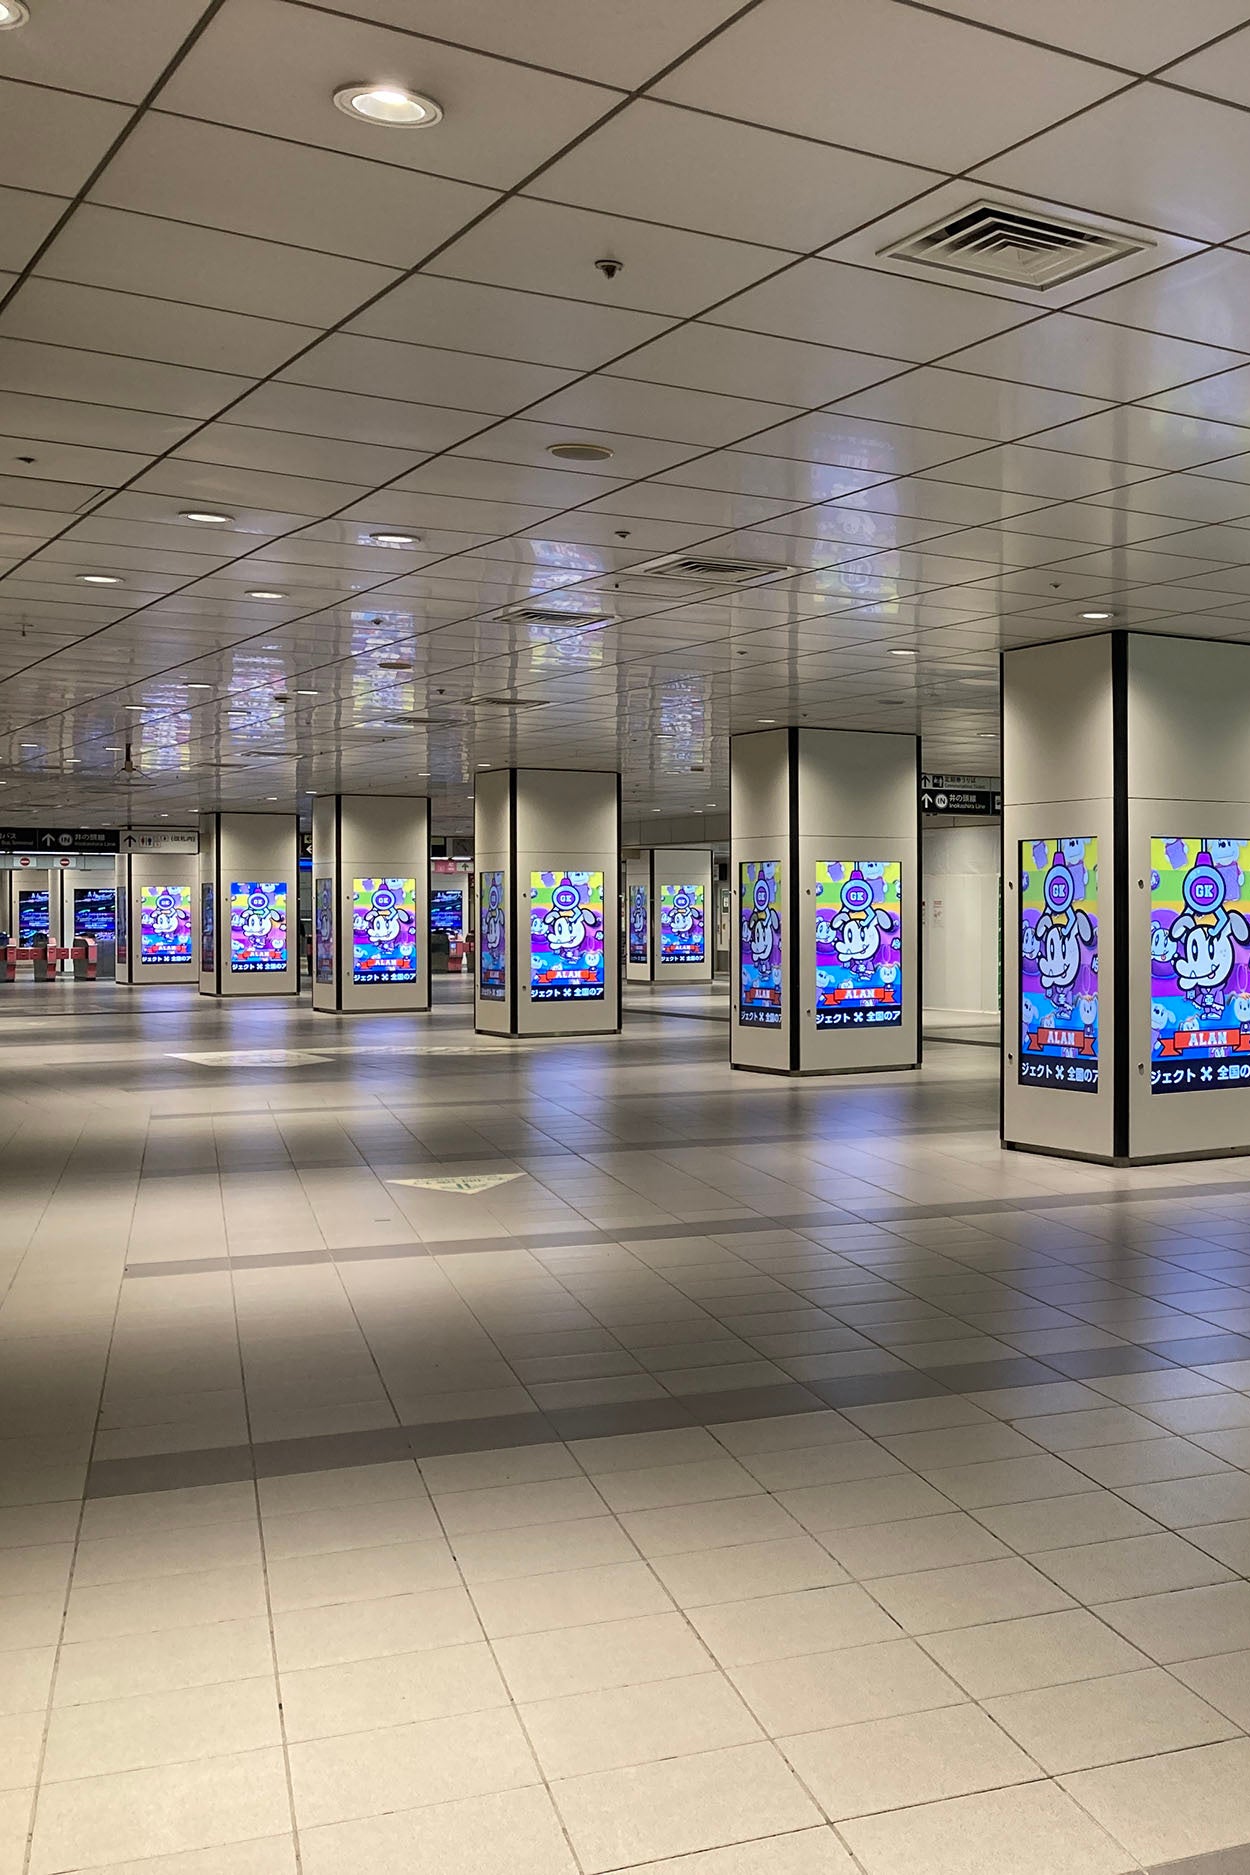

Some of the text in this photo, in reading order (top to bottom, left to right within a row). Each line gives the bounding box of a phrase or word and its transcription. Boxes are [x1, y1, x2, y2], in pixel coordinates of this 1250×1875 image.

[850, 891, 865, 901] GK
[1052, 883, 1066, 898] GK
[1195, 884, 1214, 898] GK
[531, 988, 561, 998] ジェクト
[845, 989, 875, 999] ALAN
[816, 1010, 900, 1024] ジェクト 全国のア
[1047, 1031, 1075, 1046] ALAN
[1187, 1032, 1227, 1047] ALAN
[1021, 1063, 1098, 1084] ジェクト 全国のア
[1151, 1068, 1196, 1085] ジェクト
